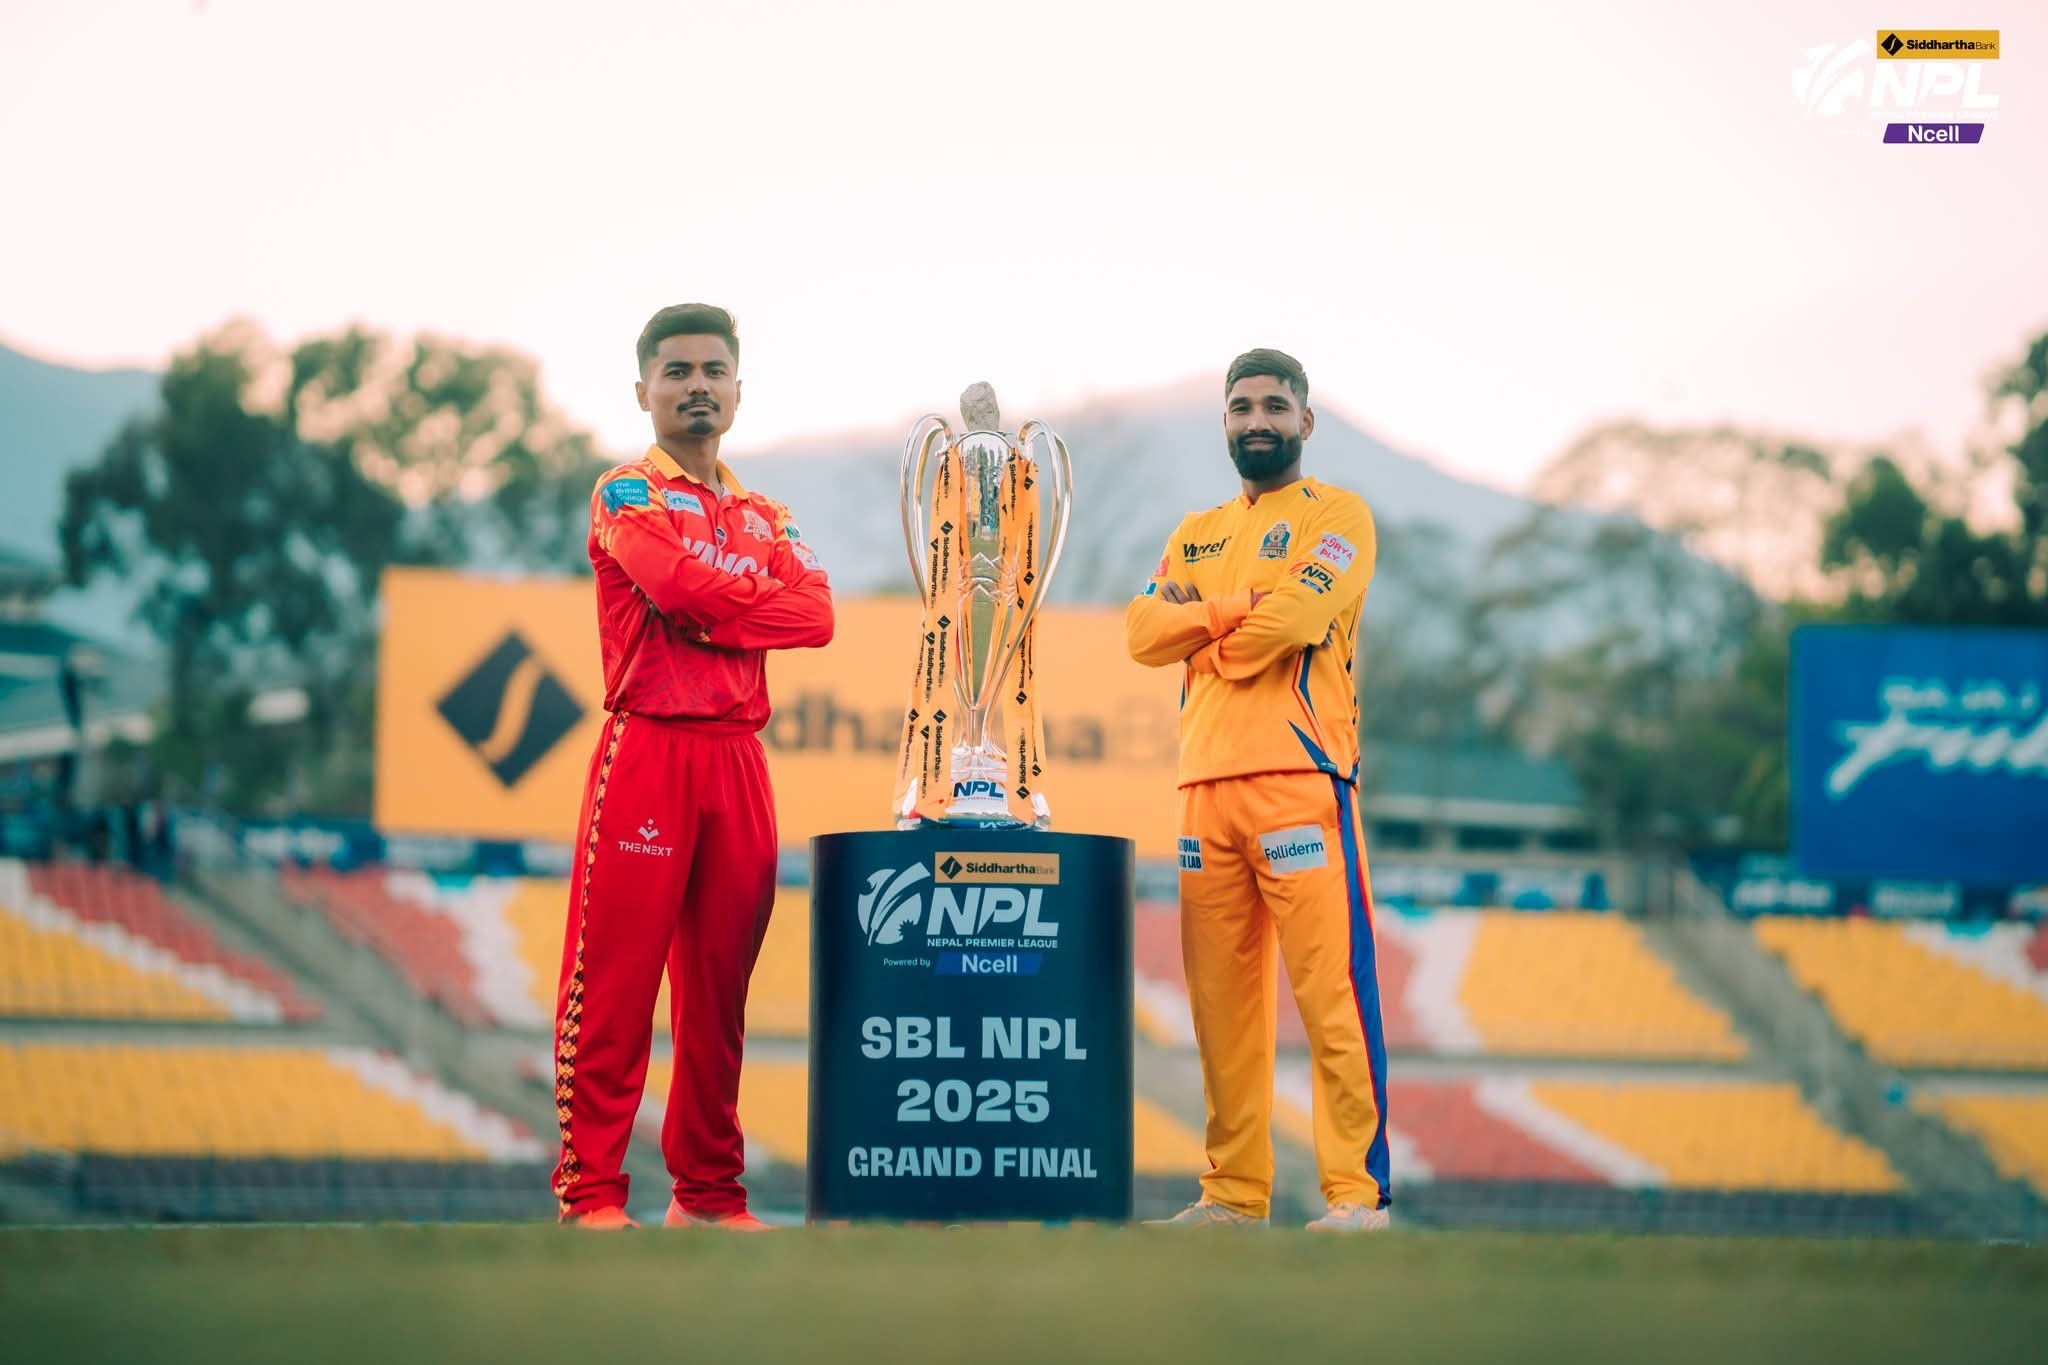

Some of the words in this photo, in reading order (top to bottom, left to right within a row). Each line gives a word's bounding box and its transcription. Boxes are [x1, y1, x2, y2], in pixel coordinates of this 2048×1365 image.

[1301, 565, 1333, 592] NPL
[953, 781, 1004, 798] NPL
[1264, 841, 1324, 861] Folliderm
[1187, 856, 1202, 869] LAB
[926, 887, 1060, 936] NPL
[927, 938, 963, 947] NEPAL
[965, 938, 1015, 948] PREMIER
[1017, 939, 1058, 949] LEAGUE
[883, 957, 918, 967] Powered
[919, 957, 931, 968] by
[962, 954, 1018, 973] Ncell
[861, 1016, 965, 1059] SBL
[982, 1016, 1087, 1060] NPL
[897, 1079, 1050, 1123] 2025
[848, 1146, 982, 1178] GRAND
[994, 1147, 1098, 1179] FINAL
